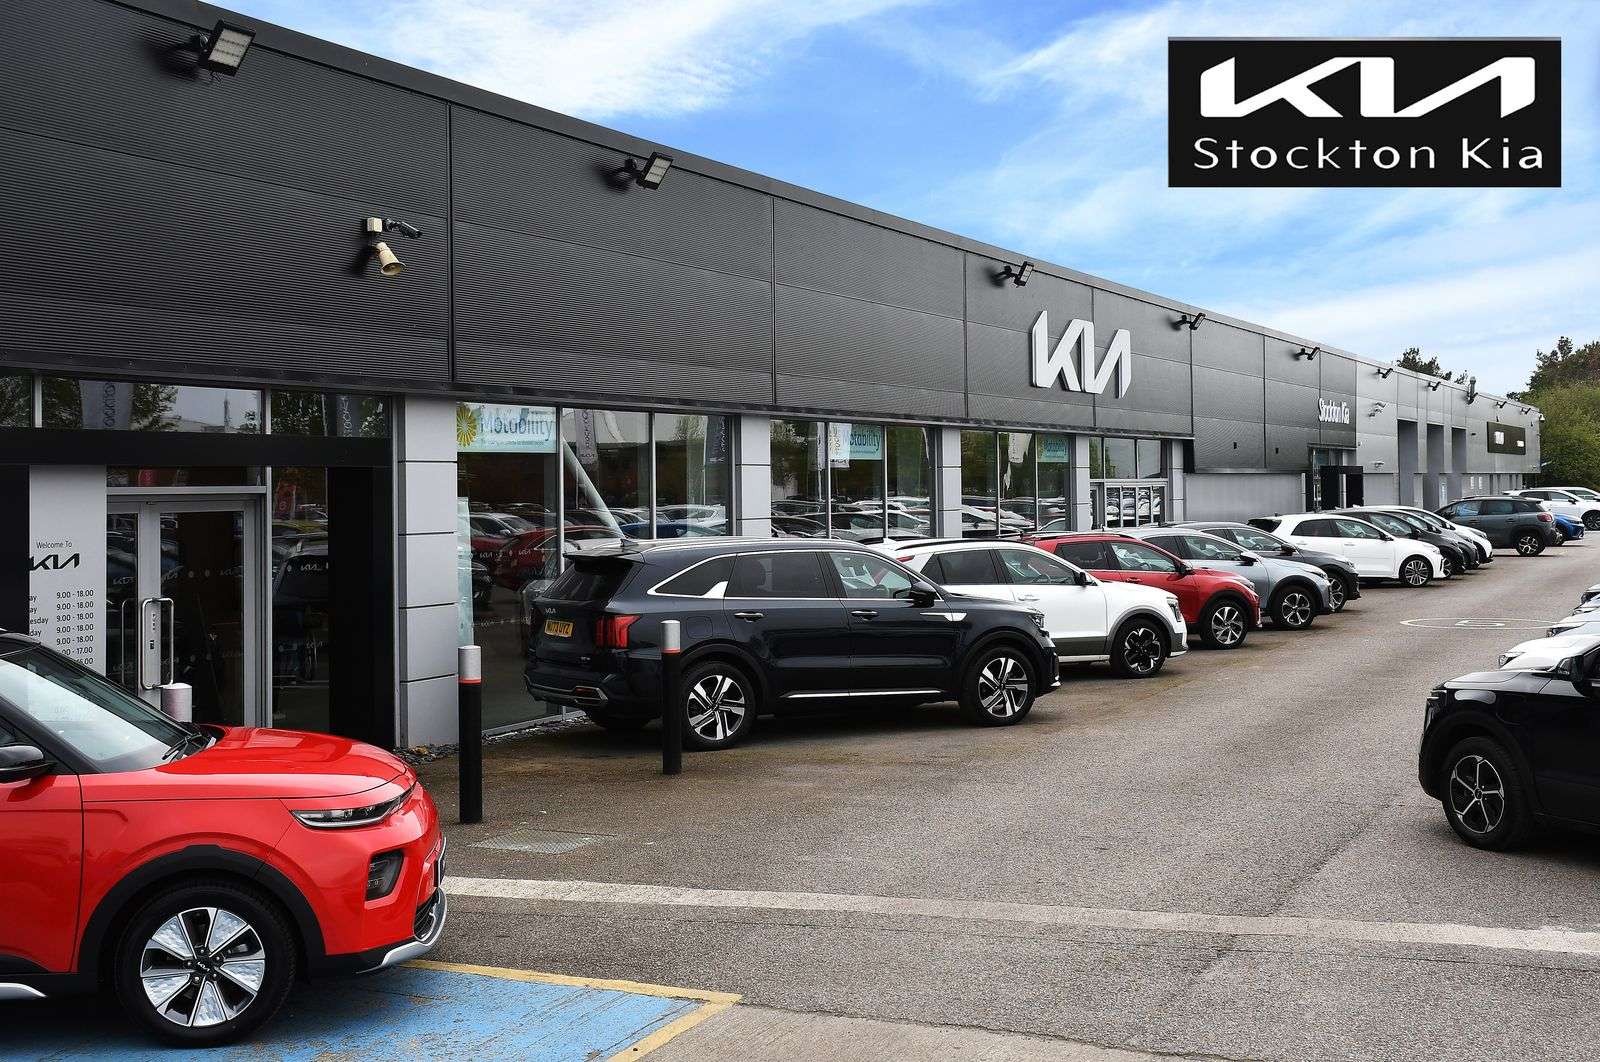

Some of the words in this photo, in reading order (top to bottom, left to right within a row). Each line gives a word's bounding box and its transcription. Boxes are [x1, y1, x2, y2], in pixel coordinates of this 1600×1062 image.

[1032, 310, 1132, 399] KIA
[36, 541, 63, 549] Welcome
[65, 540, 72, 548] To
[56, 591, 71, 599] 9.00
[76, 589, 94, 597] 18.00
[76, 601, 94, 609] 18.00
[56, 614, 71, 622] 9.00
[76, 612, 94, 620] 18.00
[76, 623, 94, 631] 18.00
[56, 637, 71, 645] 9.00
[76, 646, 93, 654] 17.00
